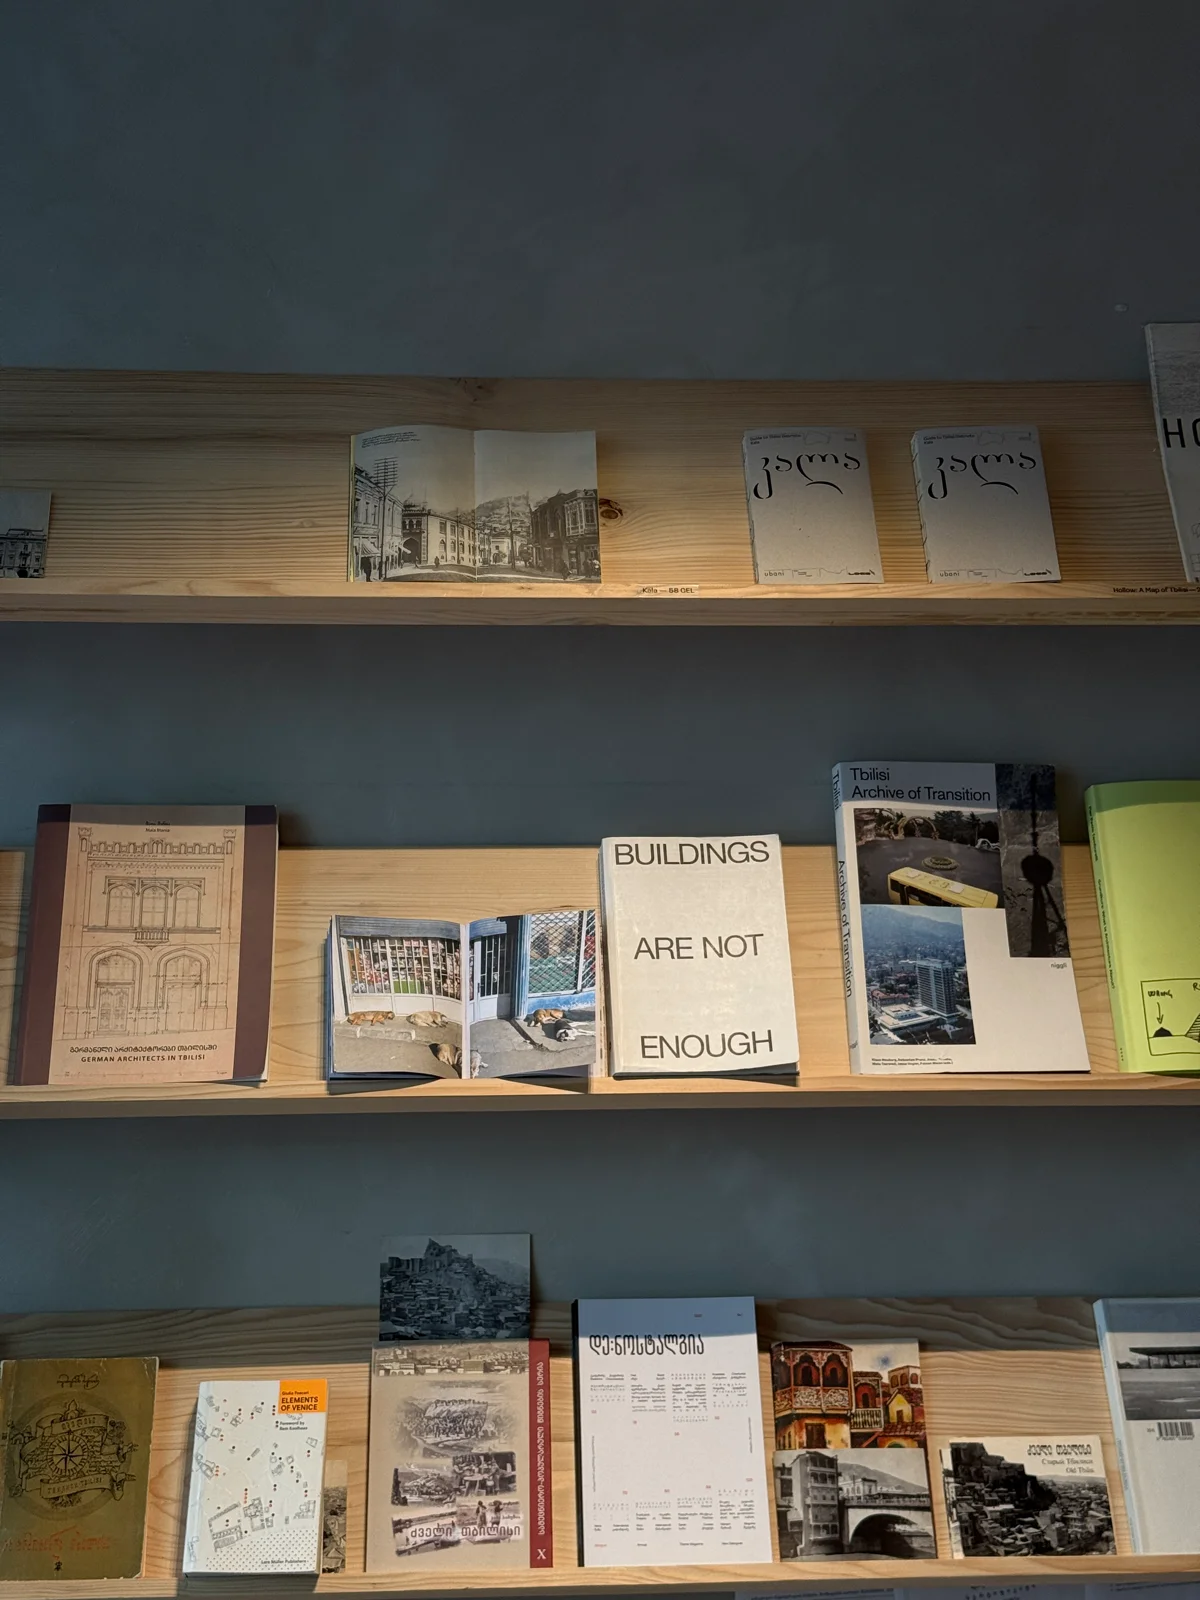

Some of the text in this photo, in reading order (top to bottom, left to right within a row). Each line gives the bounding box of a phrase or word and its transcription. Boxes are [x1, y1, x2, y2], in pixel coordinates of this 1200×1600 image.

[850, 767, 890, 781] Tbilisi
[852, 786, 990, 801] Archive of Transition
[614, 840, 770, 866] BUILDINGS
[833, 770, 852, 998] Tbilisi Archive of Transition
[634, 934, 764, 960] ARE NOT
[640, 1030, 773, 1058] ENOUGH
[410, 1525, 521, 1538] ძველი თბილისი
